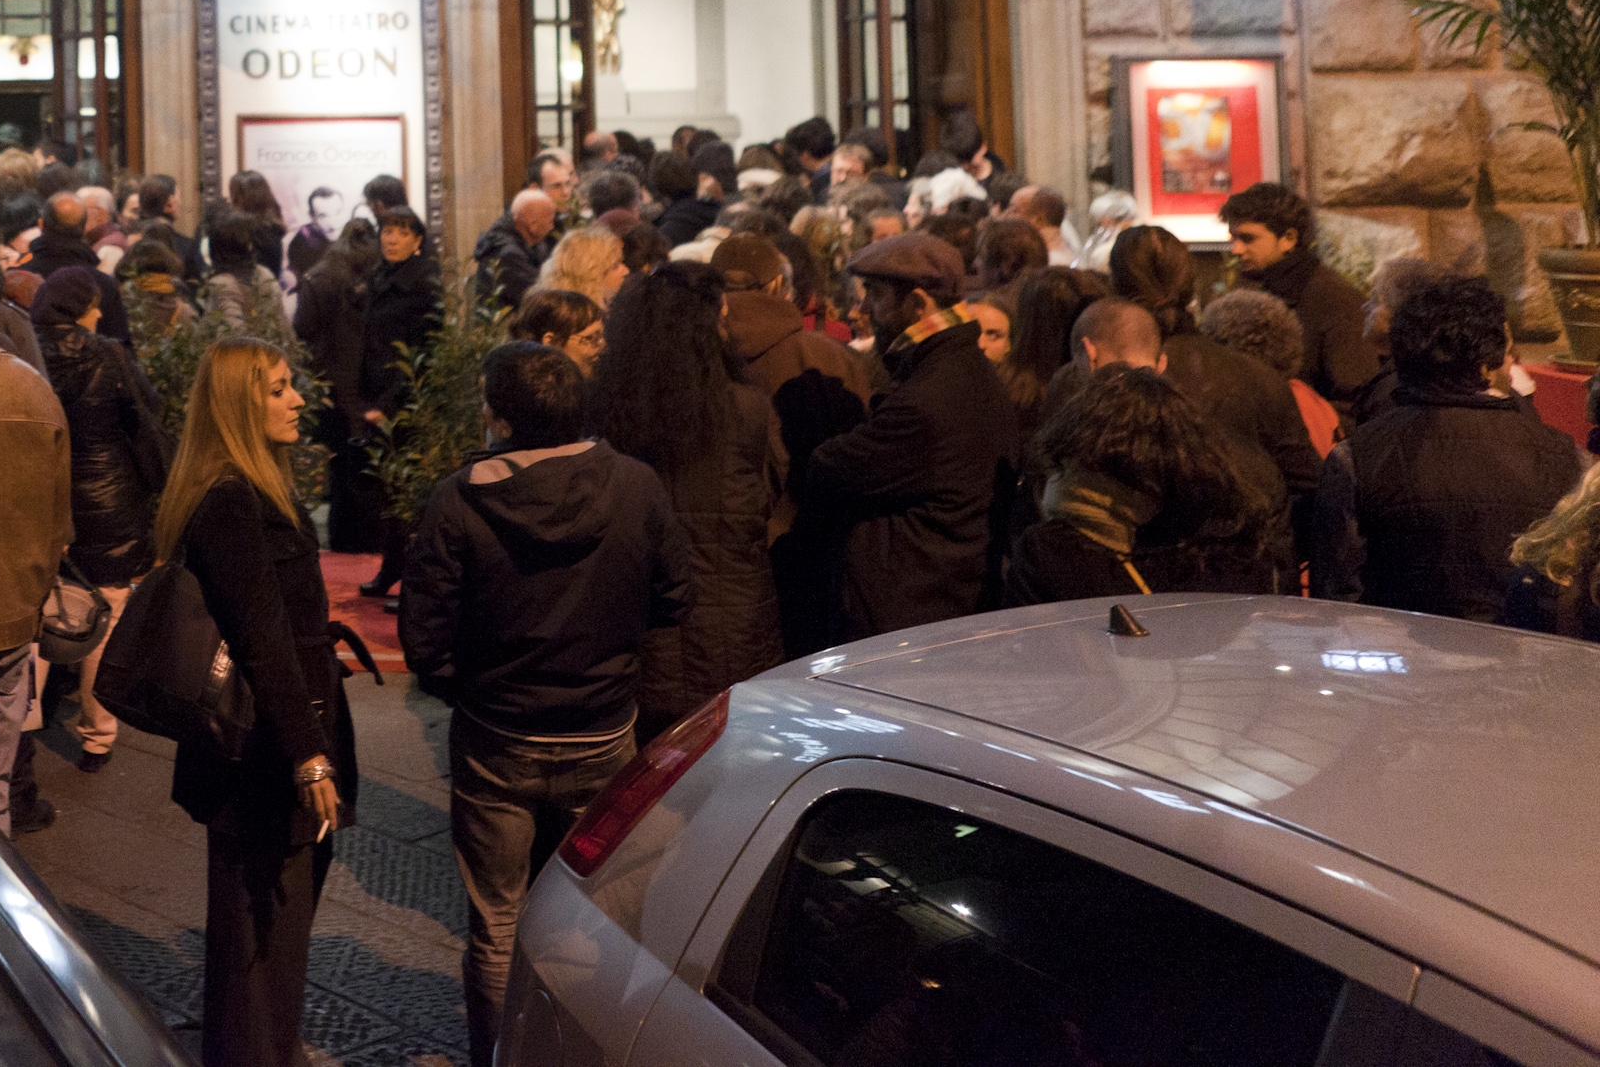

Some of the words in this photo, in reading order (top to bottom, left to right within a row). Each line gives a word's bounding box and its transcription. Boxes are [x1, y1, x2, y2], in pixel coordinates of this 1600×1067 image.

[229, 13, 311, 34] CINEMA
[328, 12, 410, 32] TEATRO
[242, 47, 398, 80] ODEON
[257, 146, 318, 163] France
[323, 145, 387, 163] Odeon
